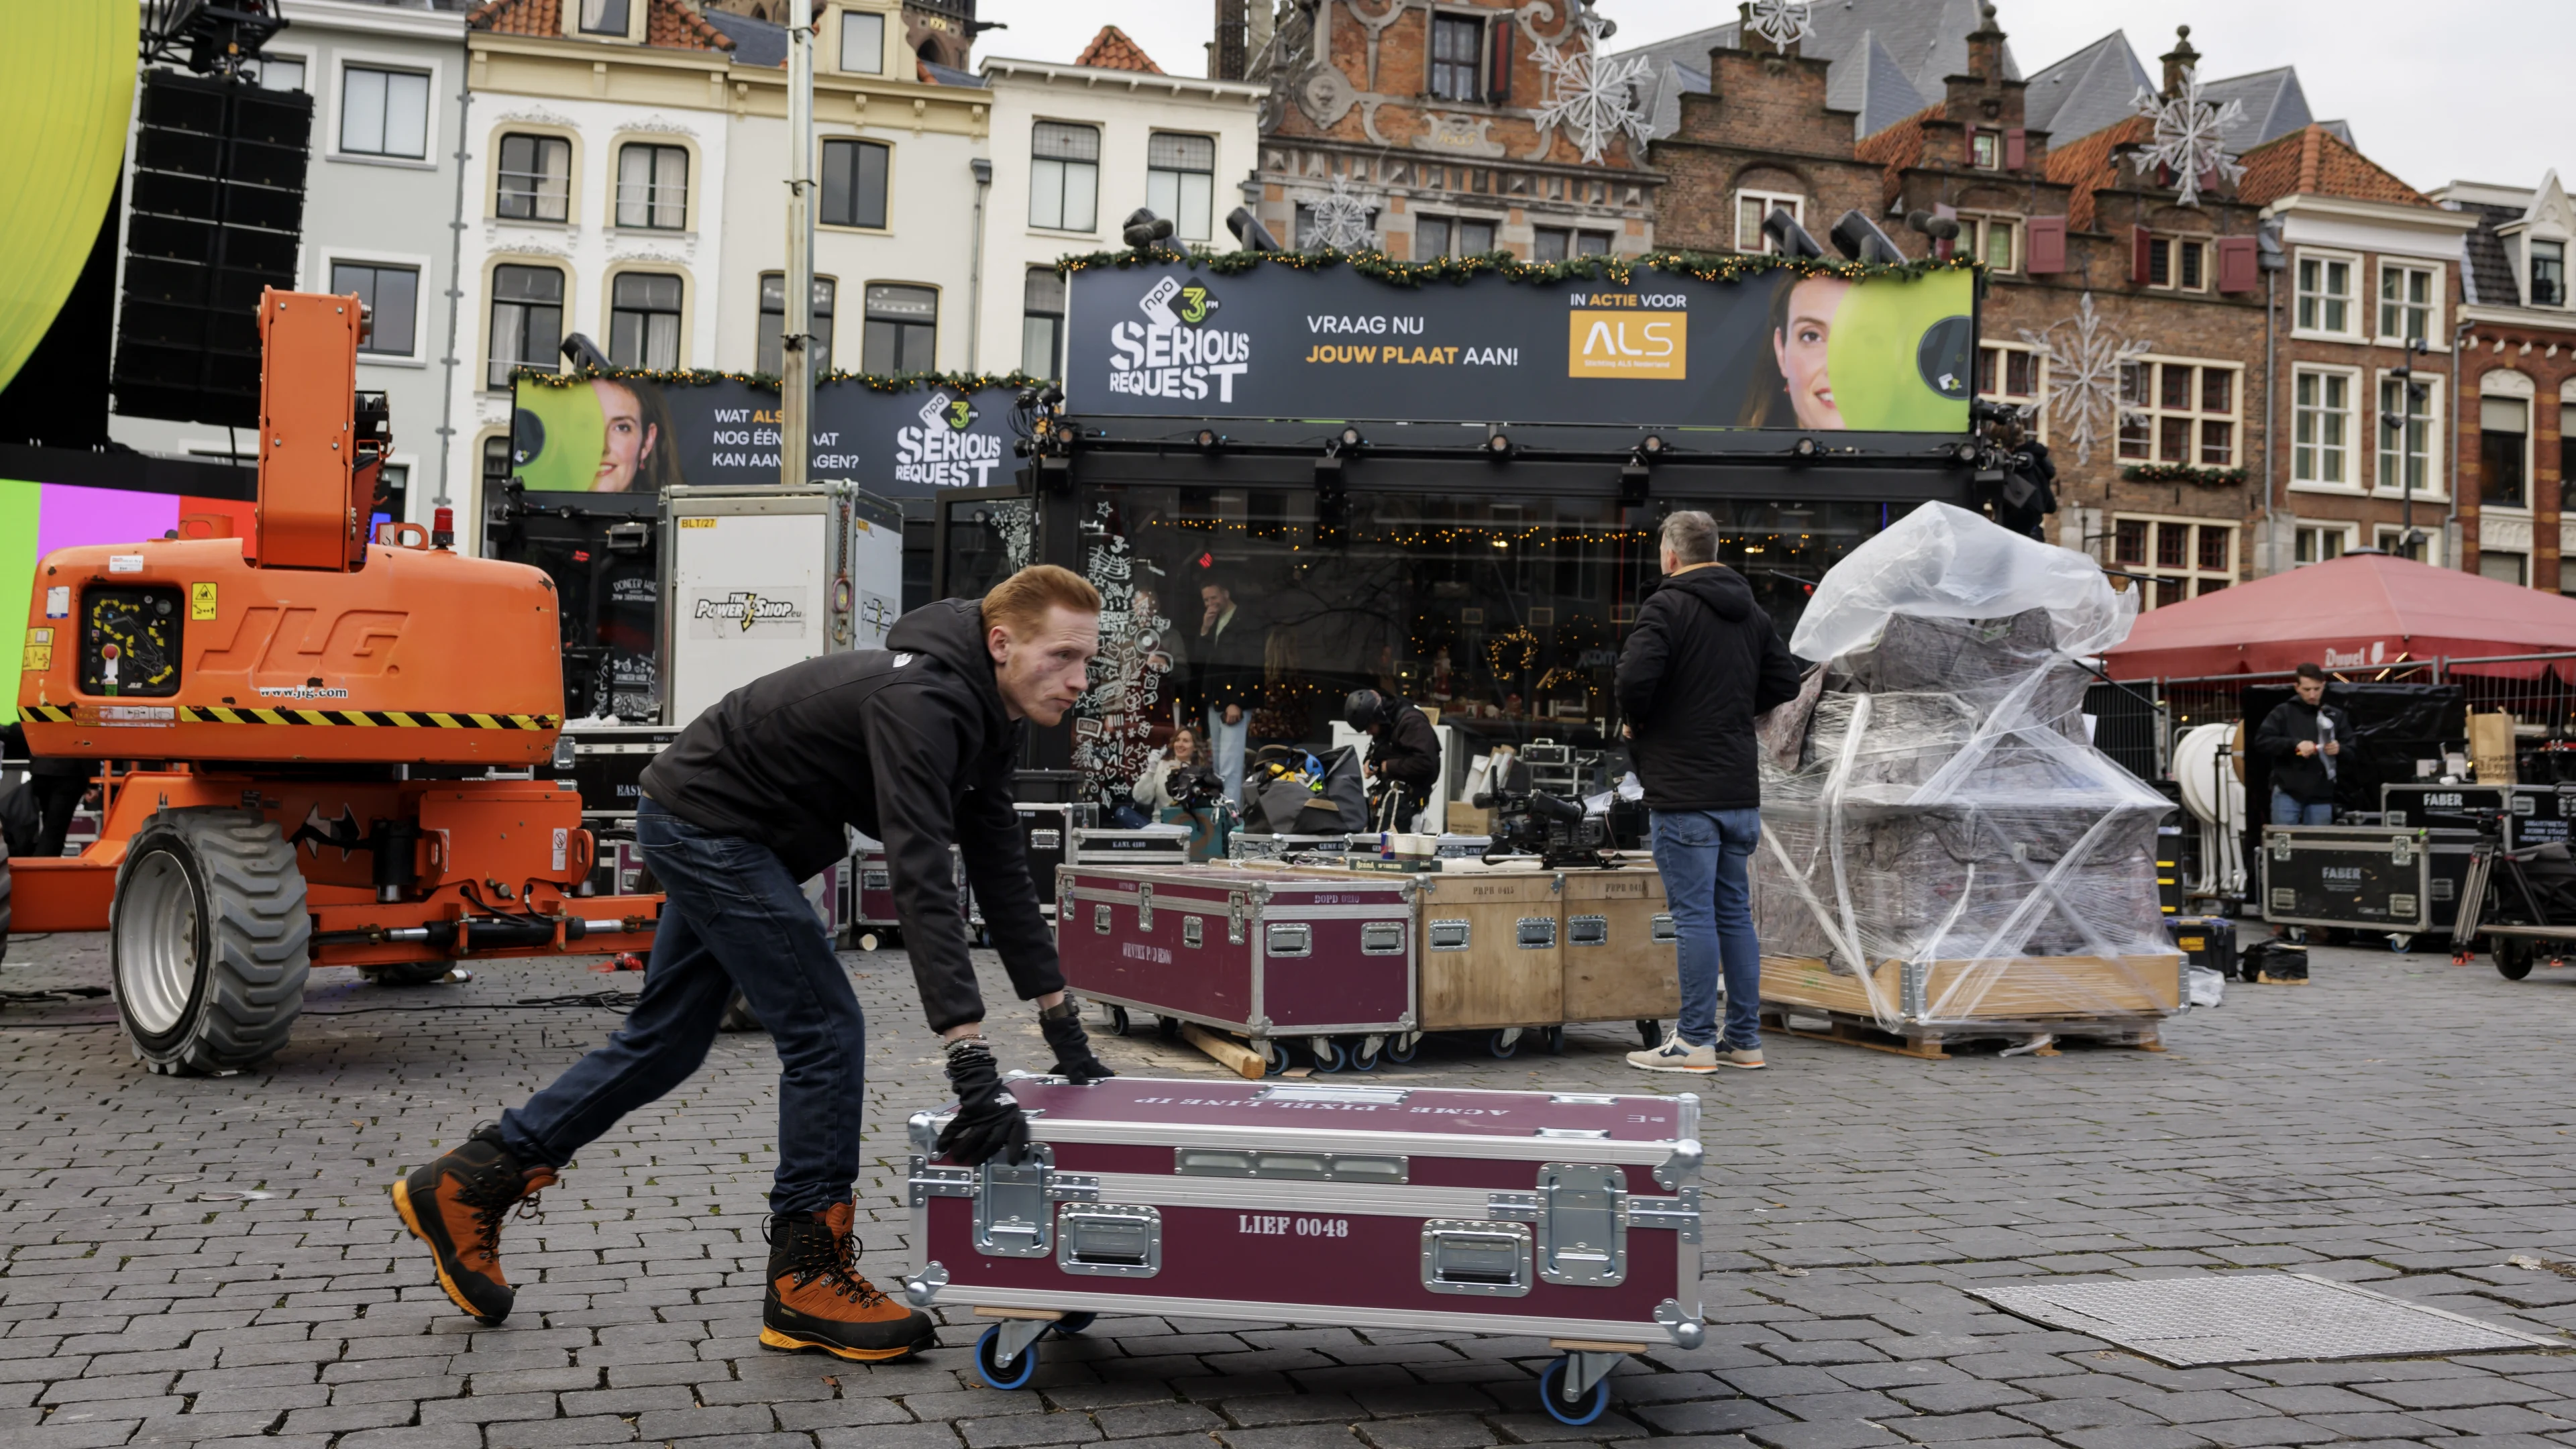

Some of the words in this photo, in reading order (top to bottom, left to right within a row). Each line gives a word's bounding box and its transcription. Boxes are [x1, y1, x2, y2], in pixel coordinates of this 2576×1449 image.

[1144, 280, 1173, 311] npo
[1181, 287, 1207, 323] 3
[1205, 300, 1219, 309] FM
[1570, 293, 1586, 307] IN
[1589, 293, 1638, 307] ACTIE
[1640, 294, 1687, 308] VOOR
[1307, 315, 1387, 334] VRAAG
[1393, 317, 1424, 334] NU
[1109, 320, 1250, 370] SERIOUS
[1582, 321, 1674, 356] ALS
[1305, 345, 1377, 364] JOUW
[1382, 346, 1458, 365] PLAAT
[1462, 347, 1519, 366] AAN!
[1617, 360, 1632, 368] ALS
[1109, 362, 1248, 403] REQUEST
[714, 409, 750, 423] WAT
[922, 395, 945, 419] npo
[950, 401, 970, 429] 3
[713, 431, 749, 445] NOG
[895, 425, 1002, 464] SERIOUS
[712, 453, 746, 466] KAN
[895, 458, 1000, 488] REQUEST
[681, 519, 716, 528] BLT/27
[729, 593, 748, 604] THE
[196, 606, 409, 678] JLG
[2423, 793, 2463, 806] FABER
[2321, 866, 2362, 880] FABER
[1179, 1098, 1264, 1108] LINE
[1274, 1102, 1379, 1112] PIXEL
[1409, 1106, 1510, 1116] ACME
[1238, 1215, 1291, 1235] LIEF
[1295, 1218, 1349, 1238] 0048
